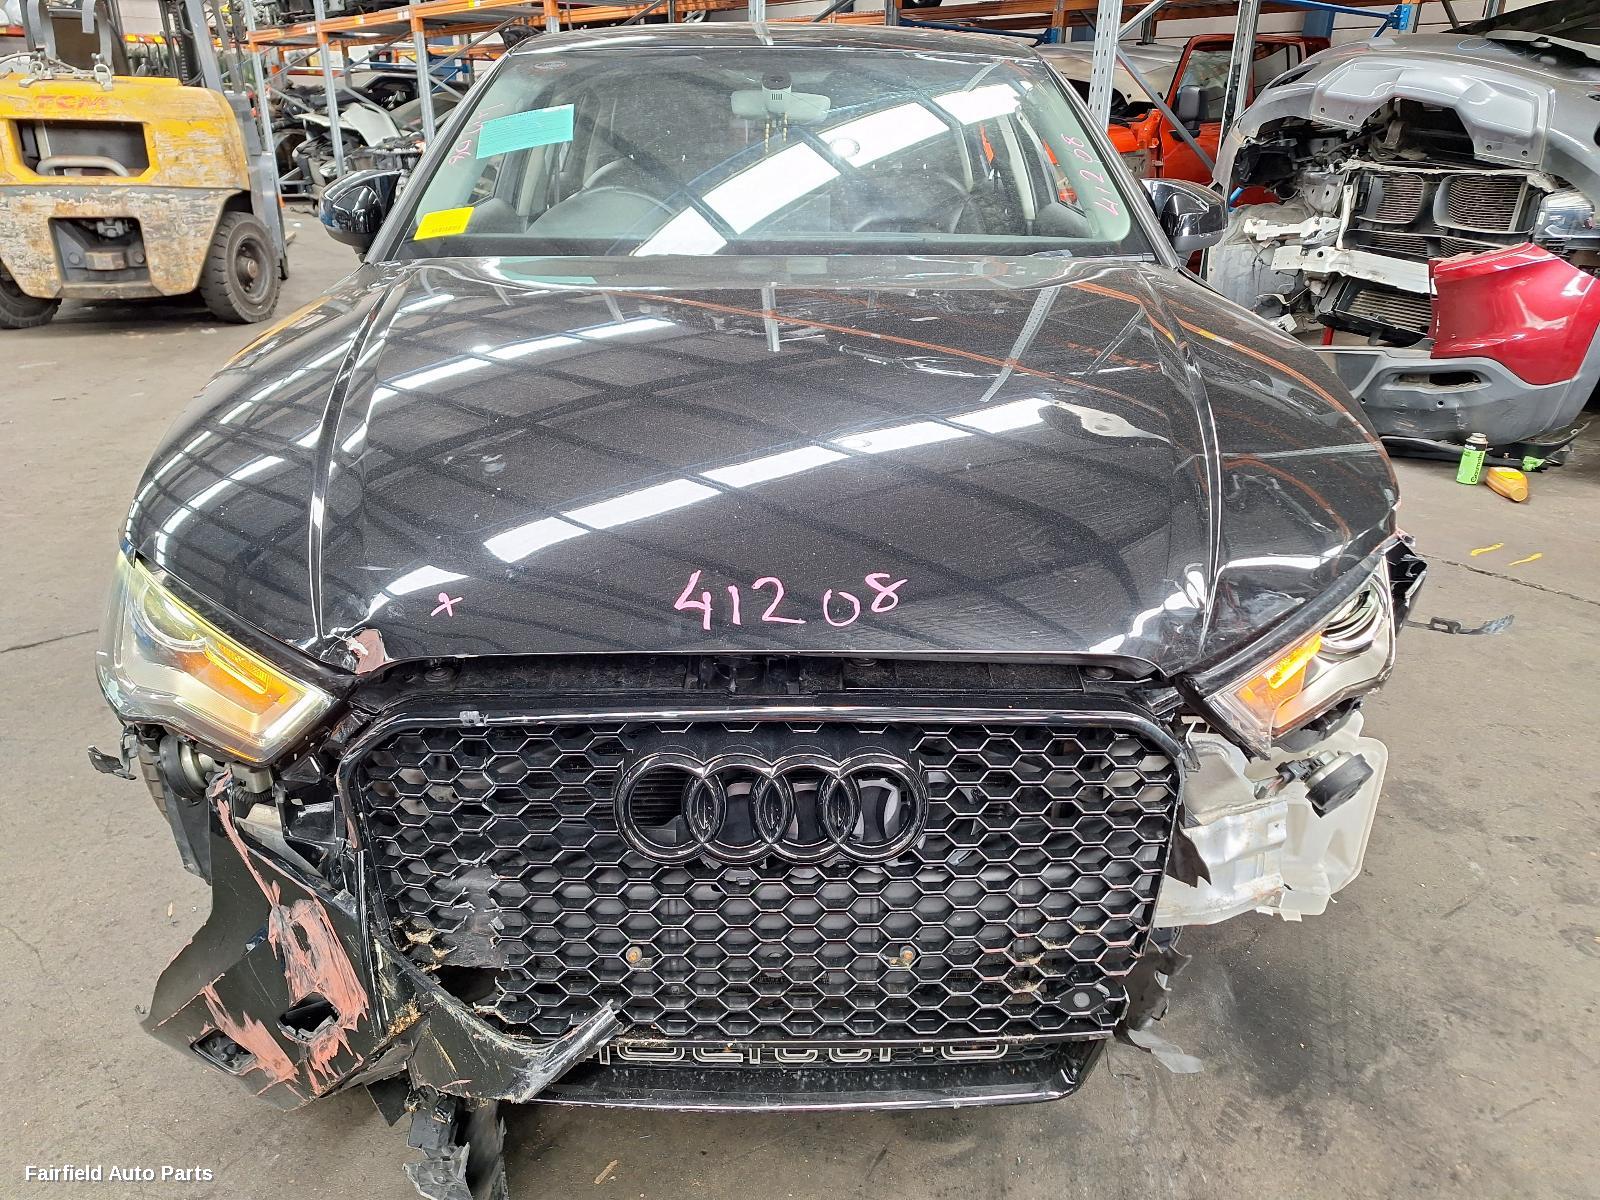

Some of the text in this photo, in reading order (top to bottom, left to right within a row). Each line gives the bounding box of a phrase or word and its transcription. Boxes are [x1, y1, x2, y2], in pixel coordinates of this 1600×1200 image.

[34, 95, 108, 110] TCM
[1060, 133, 1119, 216] 41208
[673, 570, 908, 631] 41208
